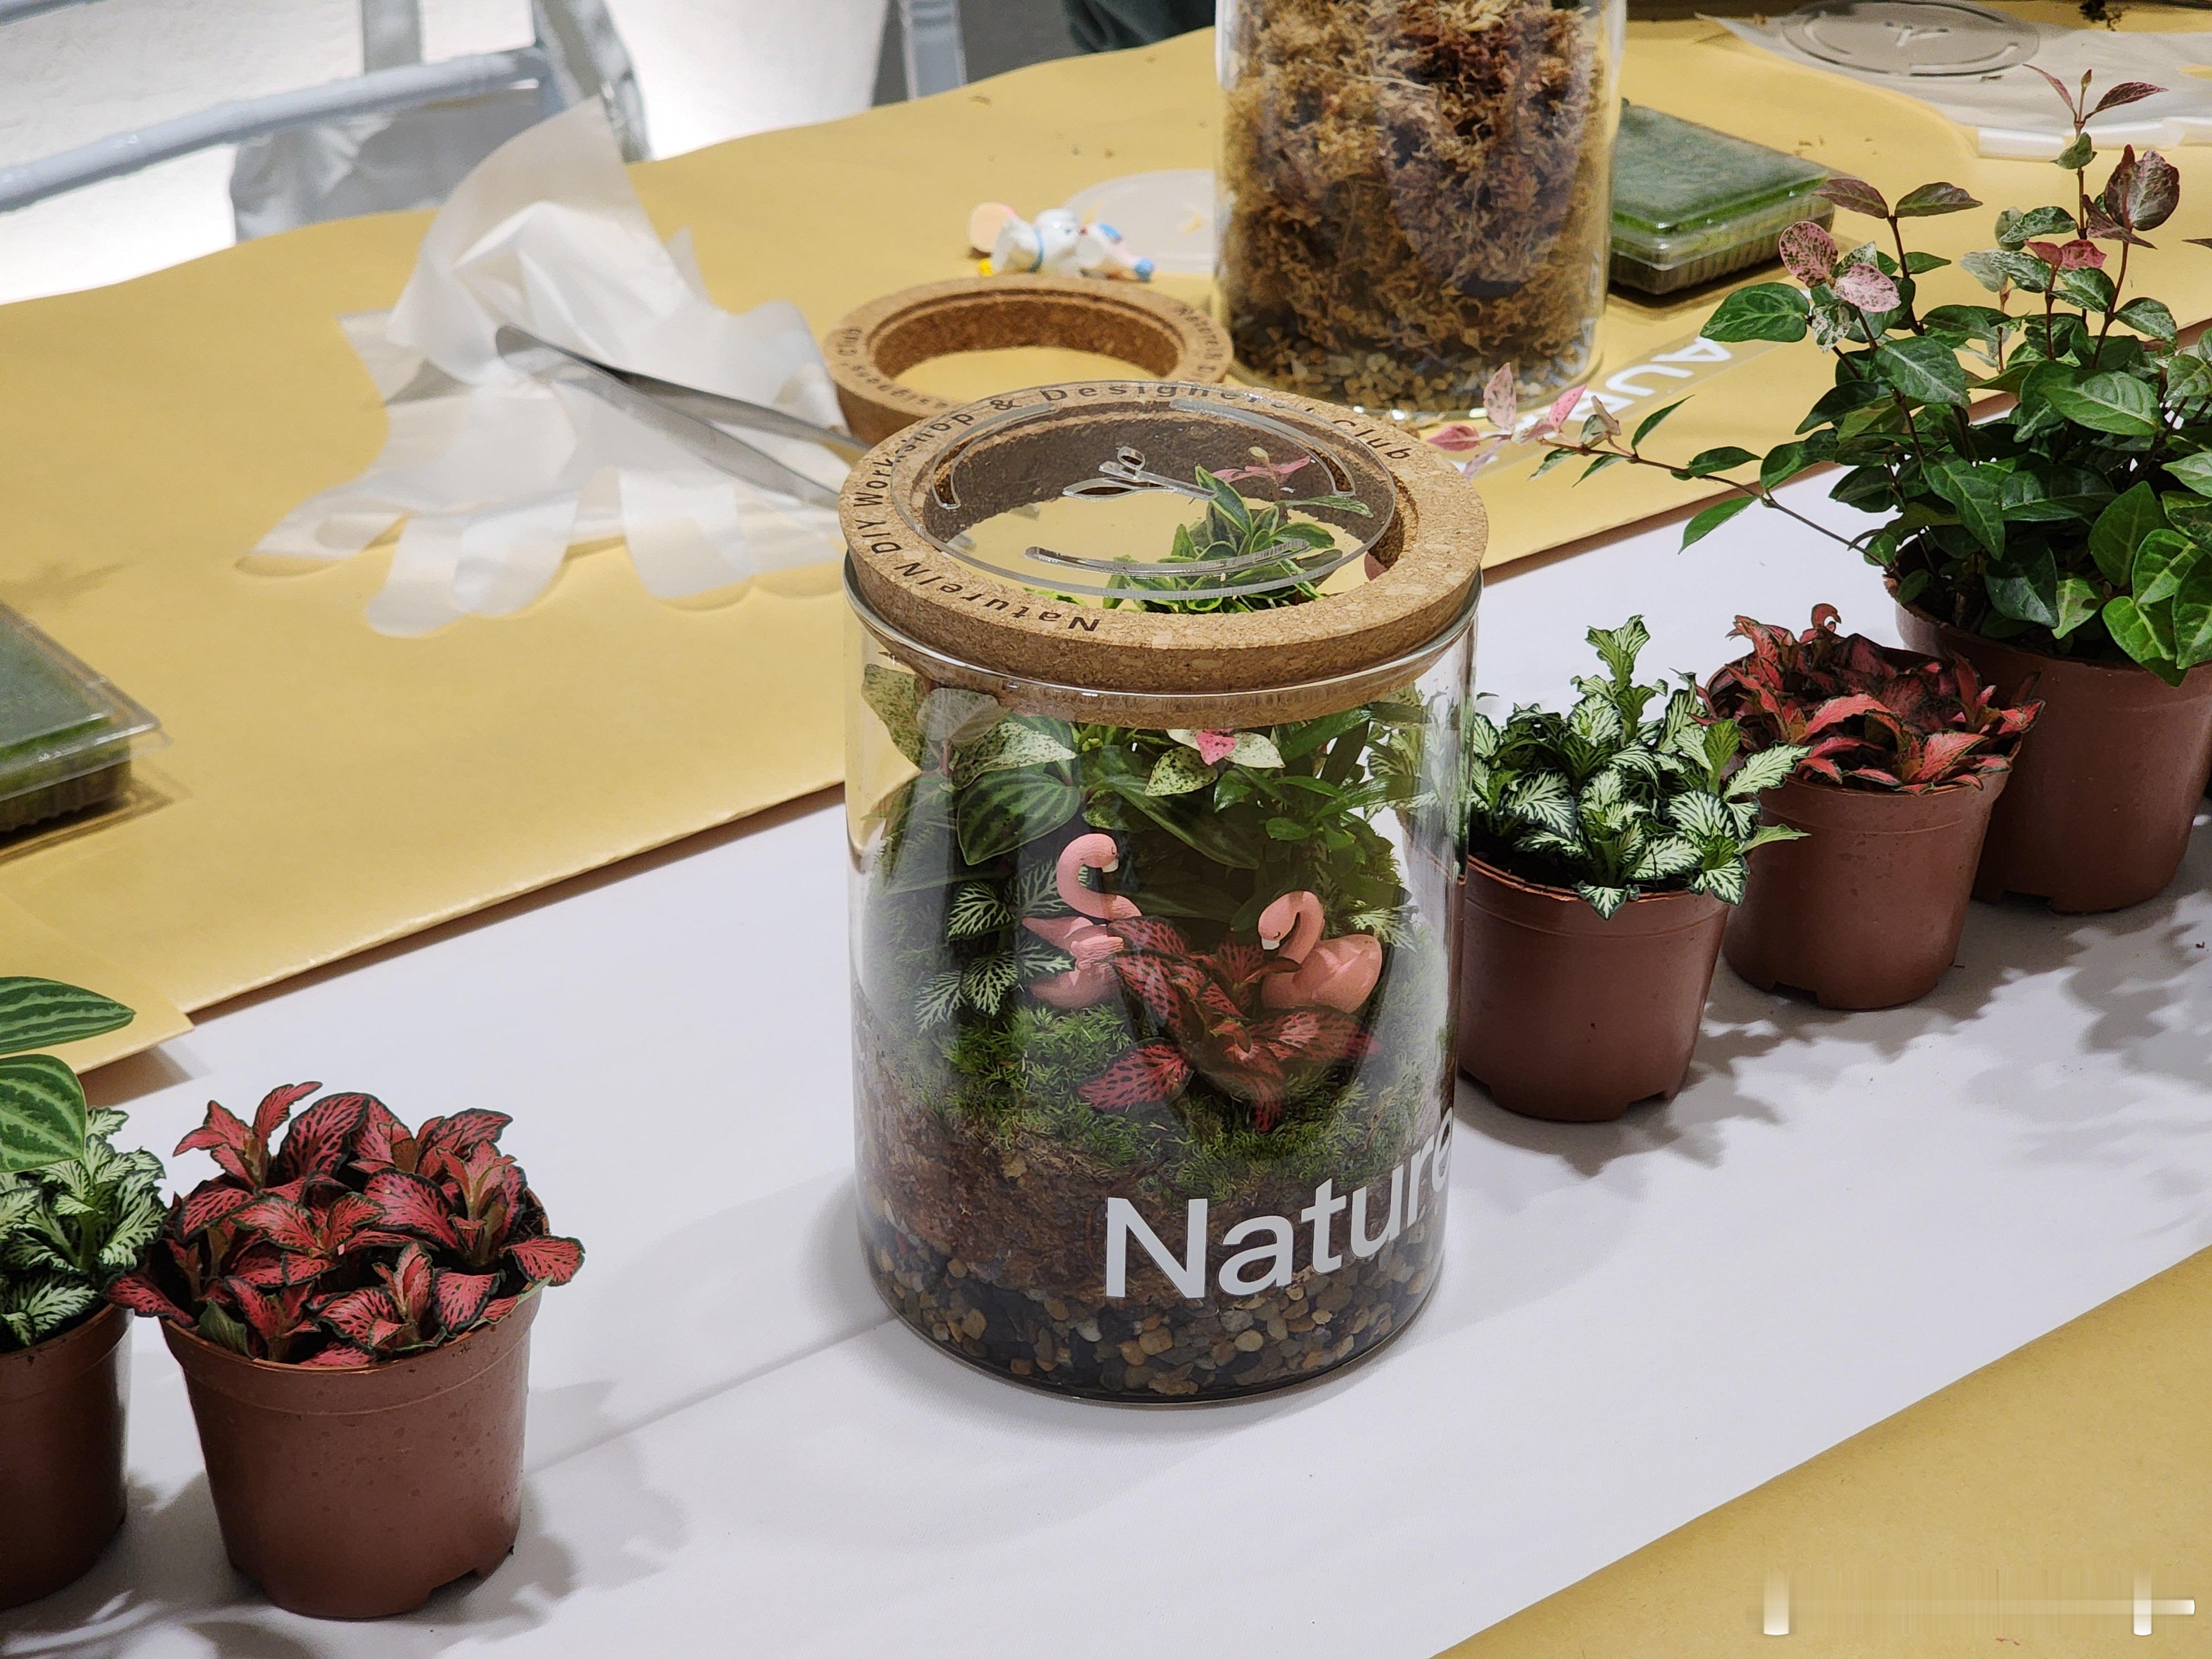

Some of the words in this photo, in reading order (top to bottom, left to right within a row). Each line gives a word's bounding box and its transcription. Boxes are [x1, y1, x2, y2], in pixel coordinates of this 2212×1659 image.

[855, 519, 903, 554] DIY
[989, 399, 1022, 411] &
[1105, 1107, 1453, 1299] Nature
